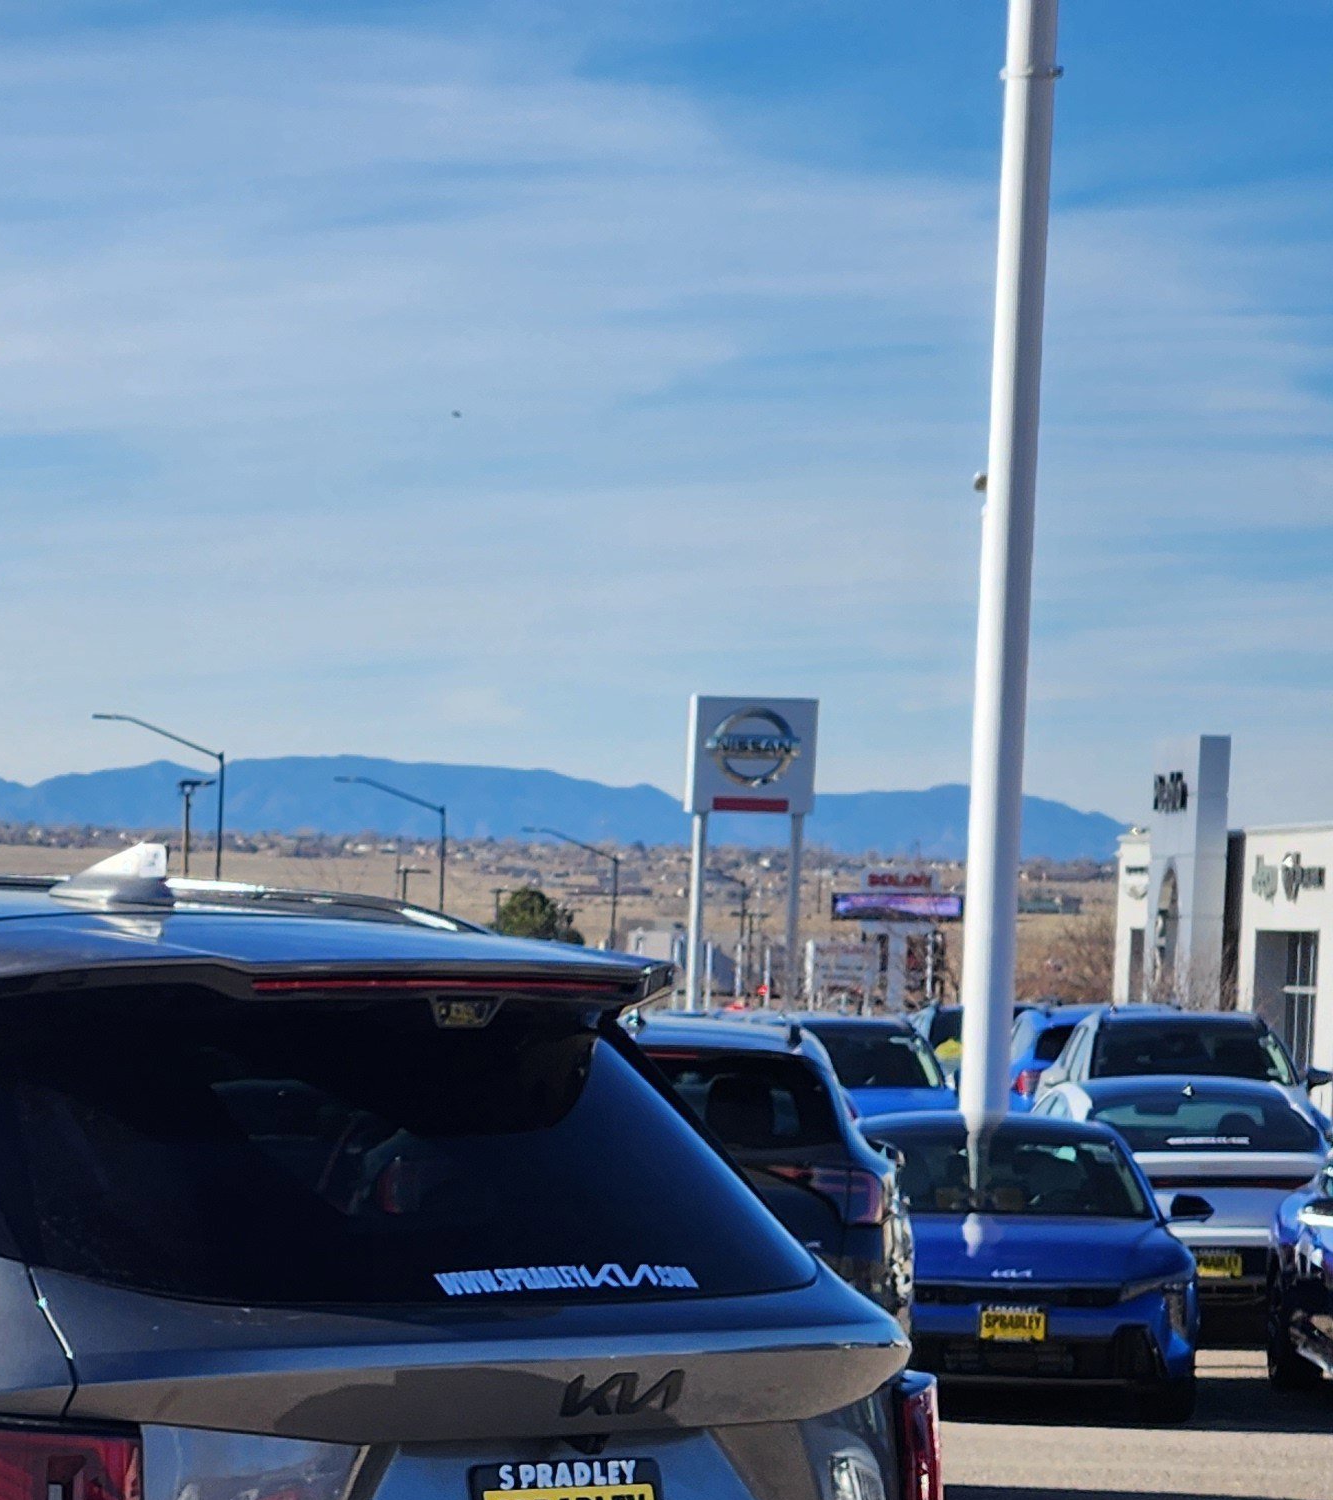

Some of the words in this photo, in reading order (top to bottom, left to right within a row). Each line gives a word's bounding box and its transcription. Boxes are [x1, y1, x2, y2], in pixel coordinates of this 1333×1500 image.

[716, 737, 794, 755] NISSAN
[983, 1312, 1042, 1330] SPRADLEY
[559, 1368, 686, 1418] KIA
